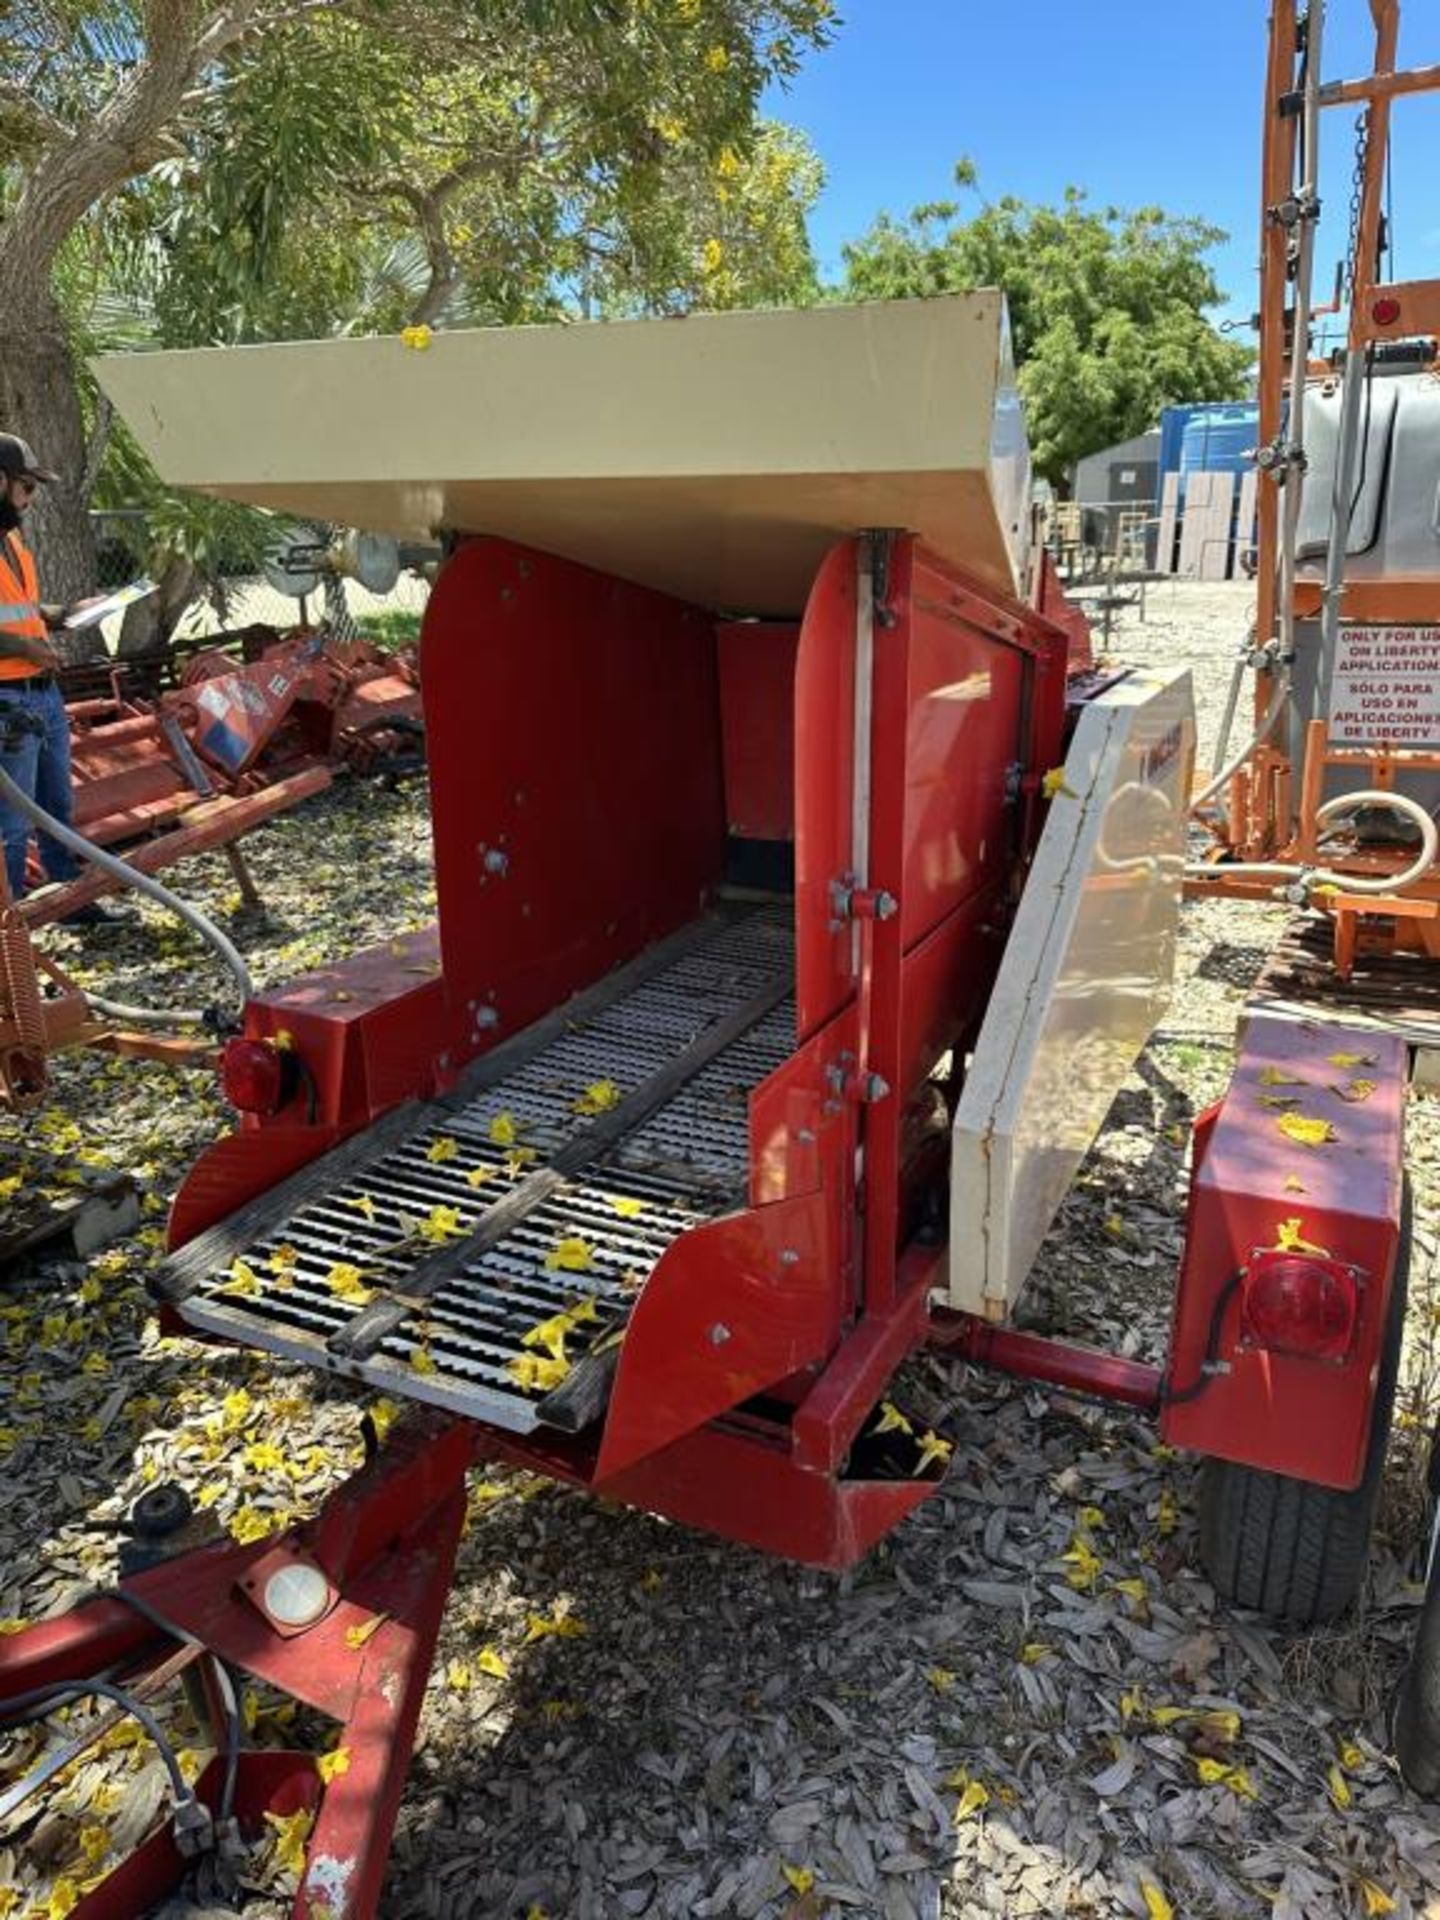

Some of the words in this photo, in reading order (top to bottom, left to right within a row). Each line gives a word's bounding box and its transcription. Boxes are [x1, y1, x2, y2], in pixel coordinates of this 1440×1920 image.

[1341, 630, 1380, 642] ONLY
[1385, 631, 1415, 642] FOR
[1349, 646, 1371, 657] ON
[1376, 645, 1440, 657] LIBERTY
[1350, 681, 1389, 694] SÓLO
[1394, 684, 1433, 694] PARA
[1362, 698, 1393, 709] USO
[1397, 699, 1419, 709] EN
[1345, 726, 1362, 737] DE
[1368, 727, 1431, 739] LIBERTY
